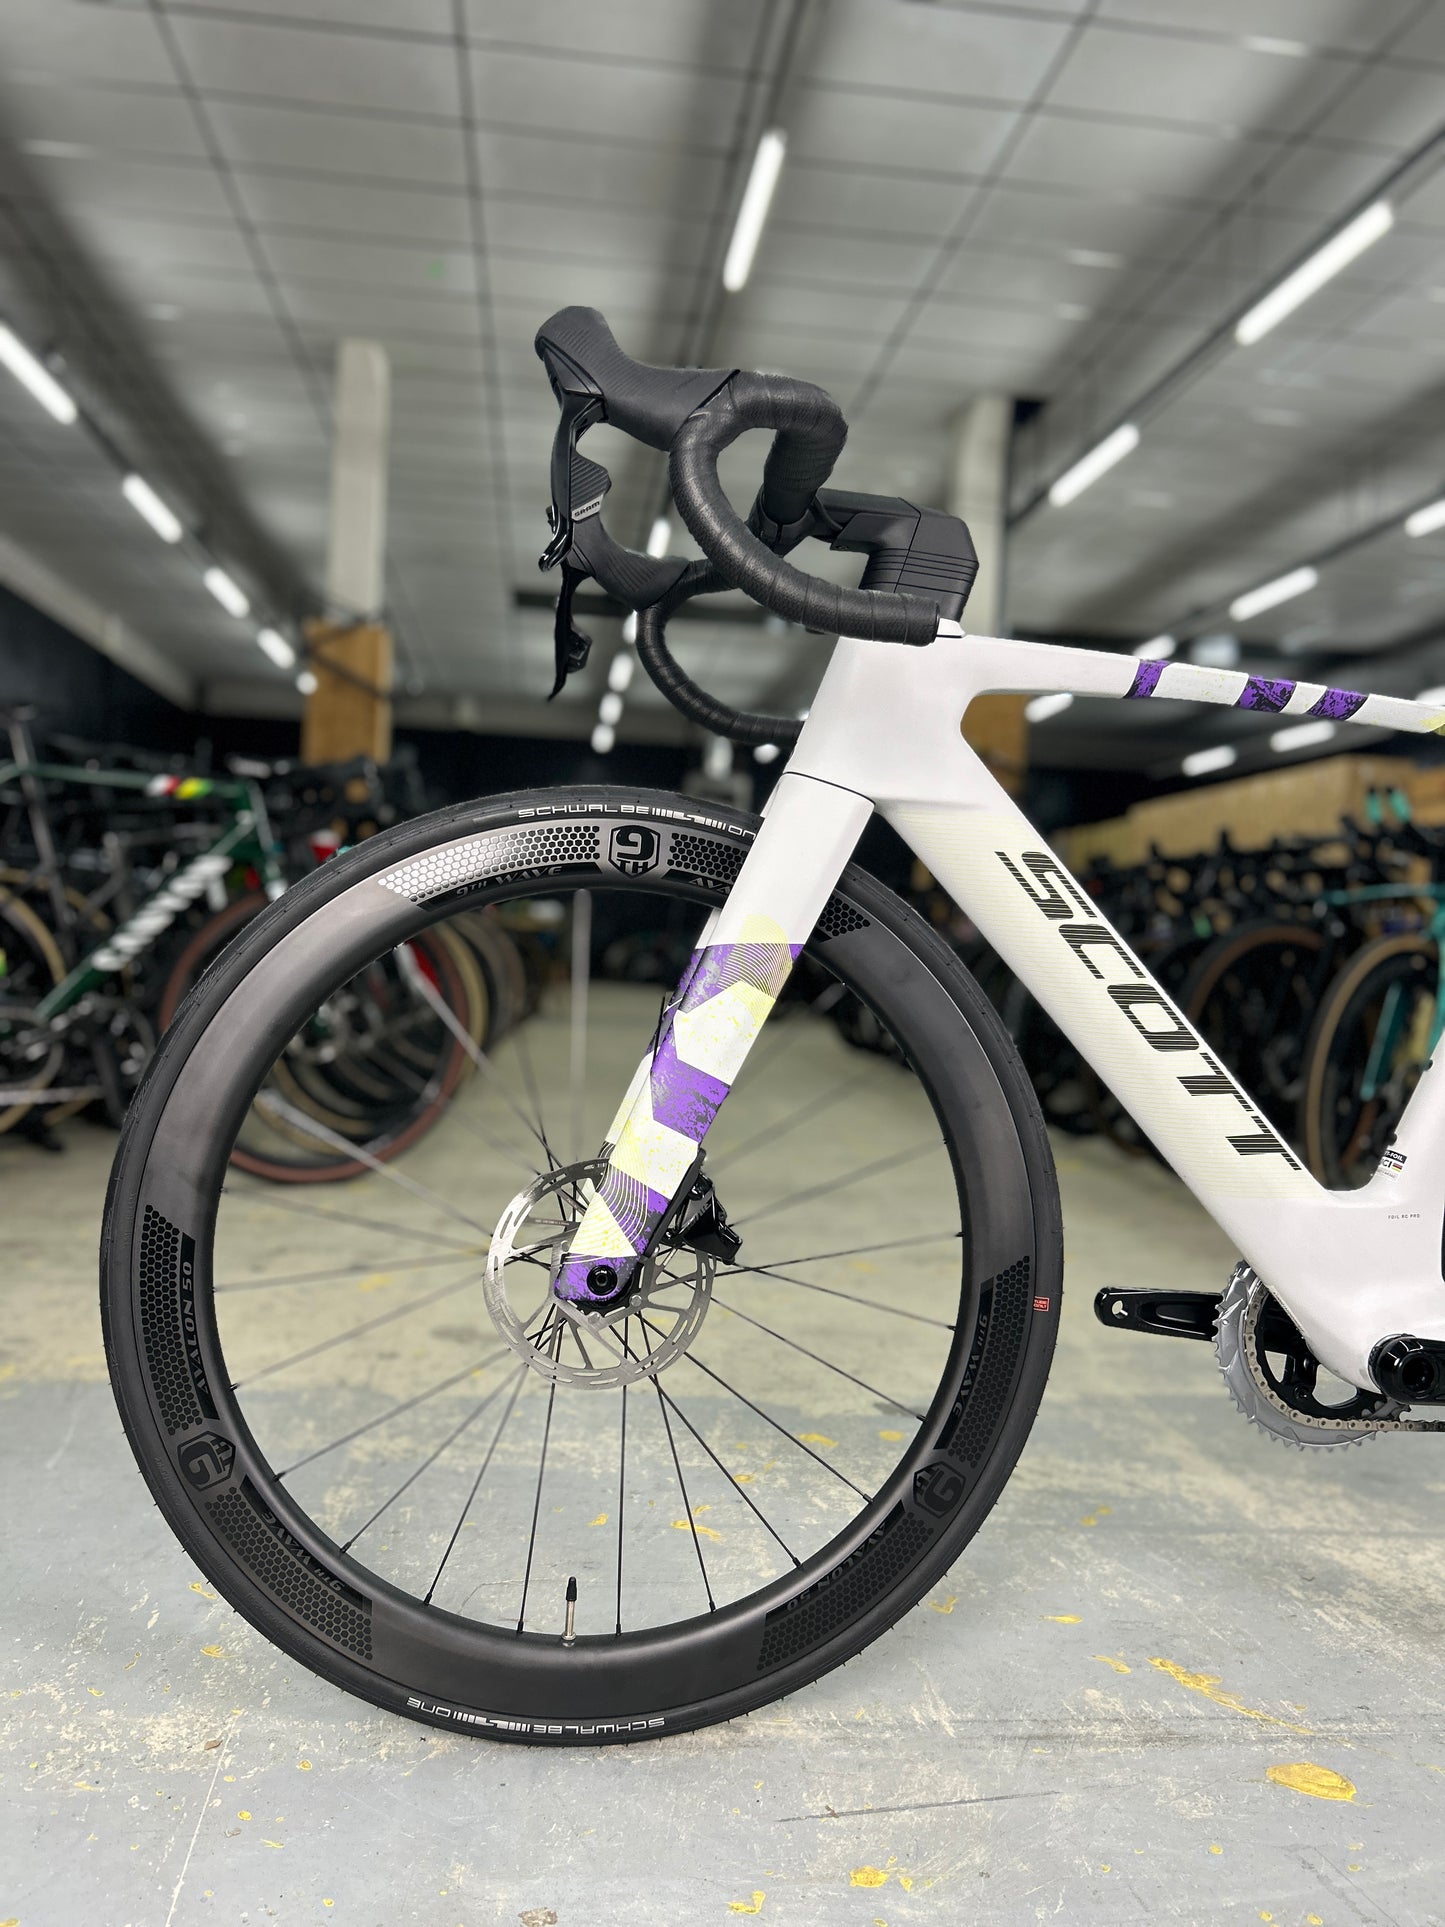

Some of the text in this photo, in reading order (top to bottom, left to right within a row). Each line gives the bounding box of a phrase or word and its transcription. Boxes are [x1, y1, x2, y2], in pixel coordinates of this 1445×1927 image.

[574, 501, 600, 517] SRAM
[518, 804, 649, 818] SCHWALBE
[495, 865, 562, 885] WAVE
[994, 851, 1302, 1171] SCOTT
[182, 1261, 209, 1394] AVALON 50
[952, 1355, 981, 1417] WAVE
[261, 1511, 311, 1566] WAVE
[818, 1523, 886, 1590] AVALON
[533, 1717, 665, 1734] SCHWALBE
